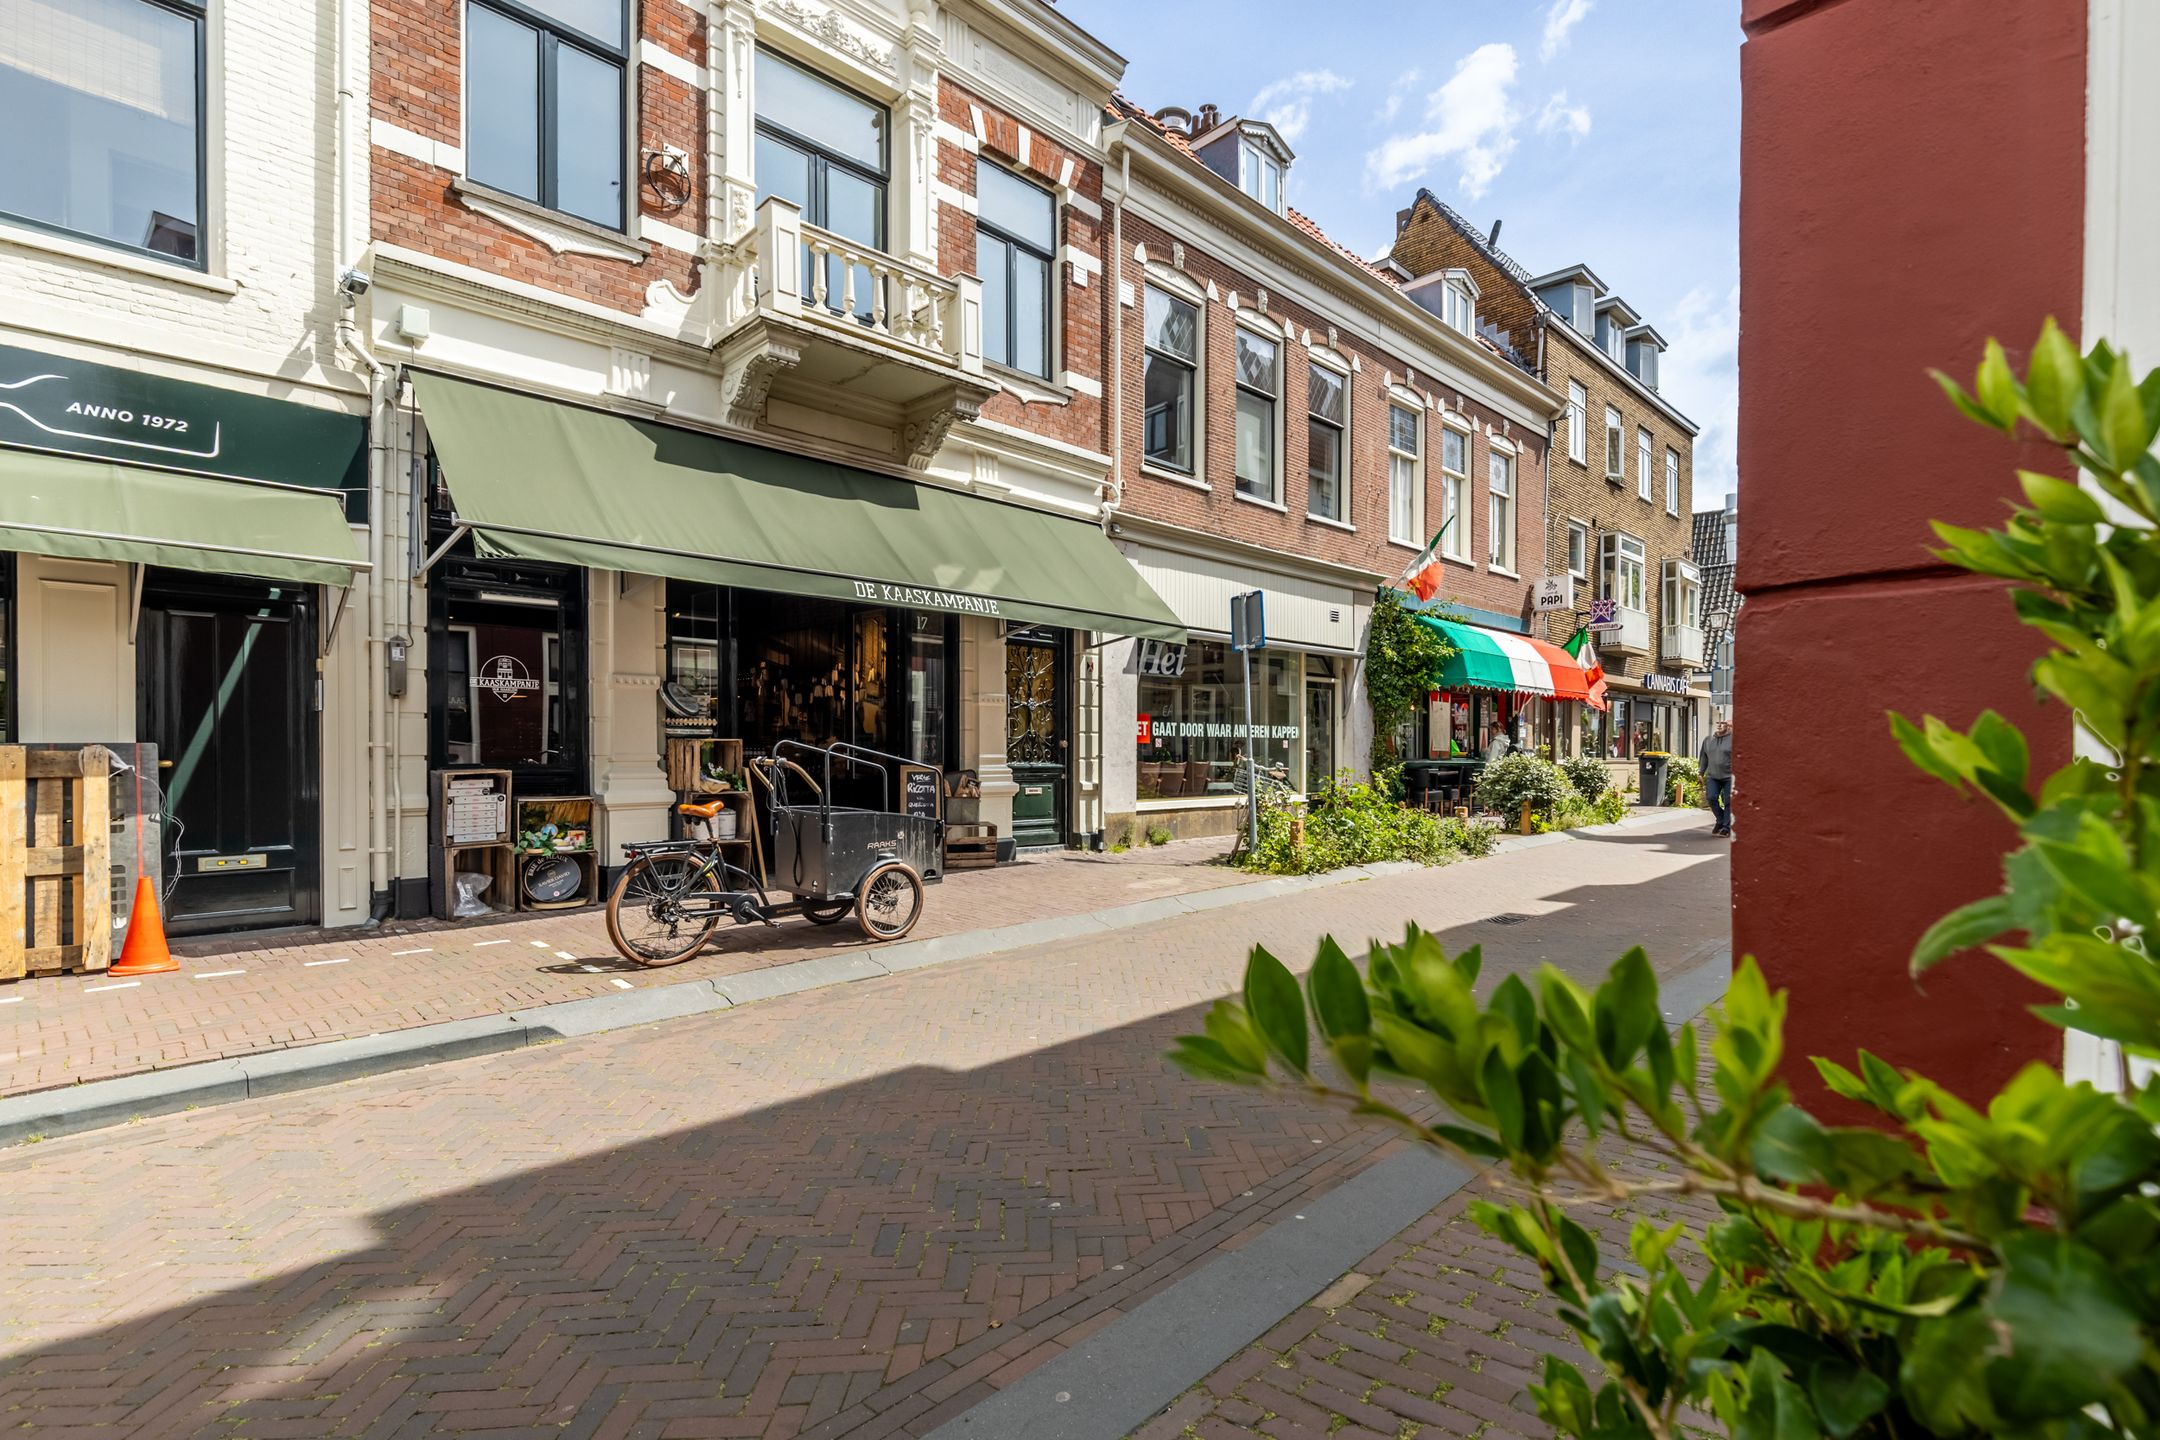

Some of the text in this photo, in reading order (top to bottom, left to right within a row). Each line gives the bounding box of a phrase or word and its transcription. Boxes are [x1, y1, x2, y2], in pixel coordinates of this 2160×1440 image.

[65, 402, 189, 432] ANNO 1972
[853, 581, 1000, 614] DE KAASKAMPANJE
[1541, 594, 1563, 606] PAPI
[916, 615, 928, 630] 17
[1138, 640, 1187, 676] Het
[479, 679, 540, 688] KAASKAMPANJE
[1647, 673, 1676, 693] CANNABIS
[1137, 721, 1148, 736] ET
[1152, 721, 1177, 737] GAAT
[1179, 722, 1203, 737] DOOR
[1206, 723, 1231, 738] WAAR
